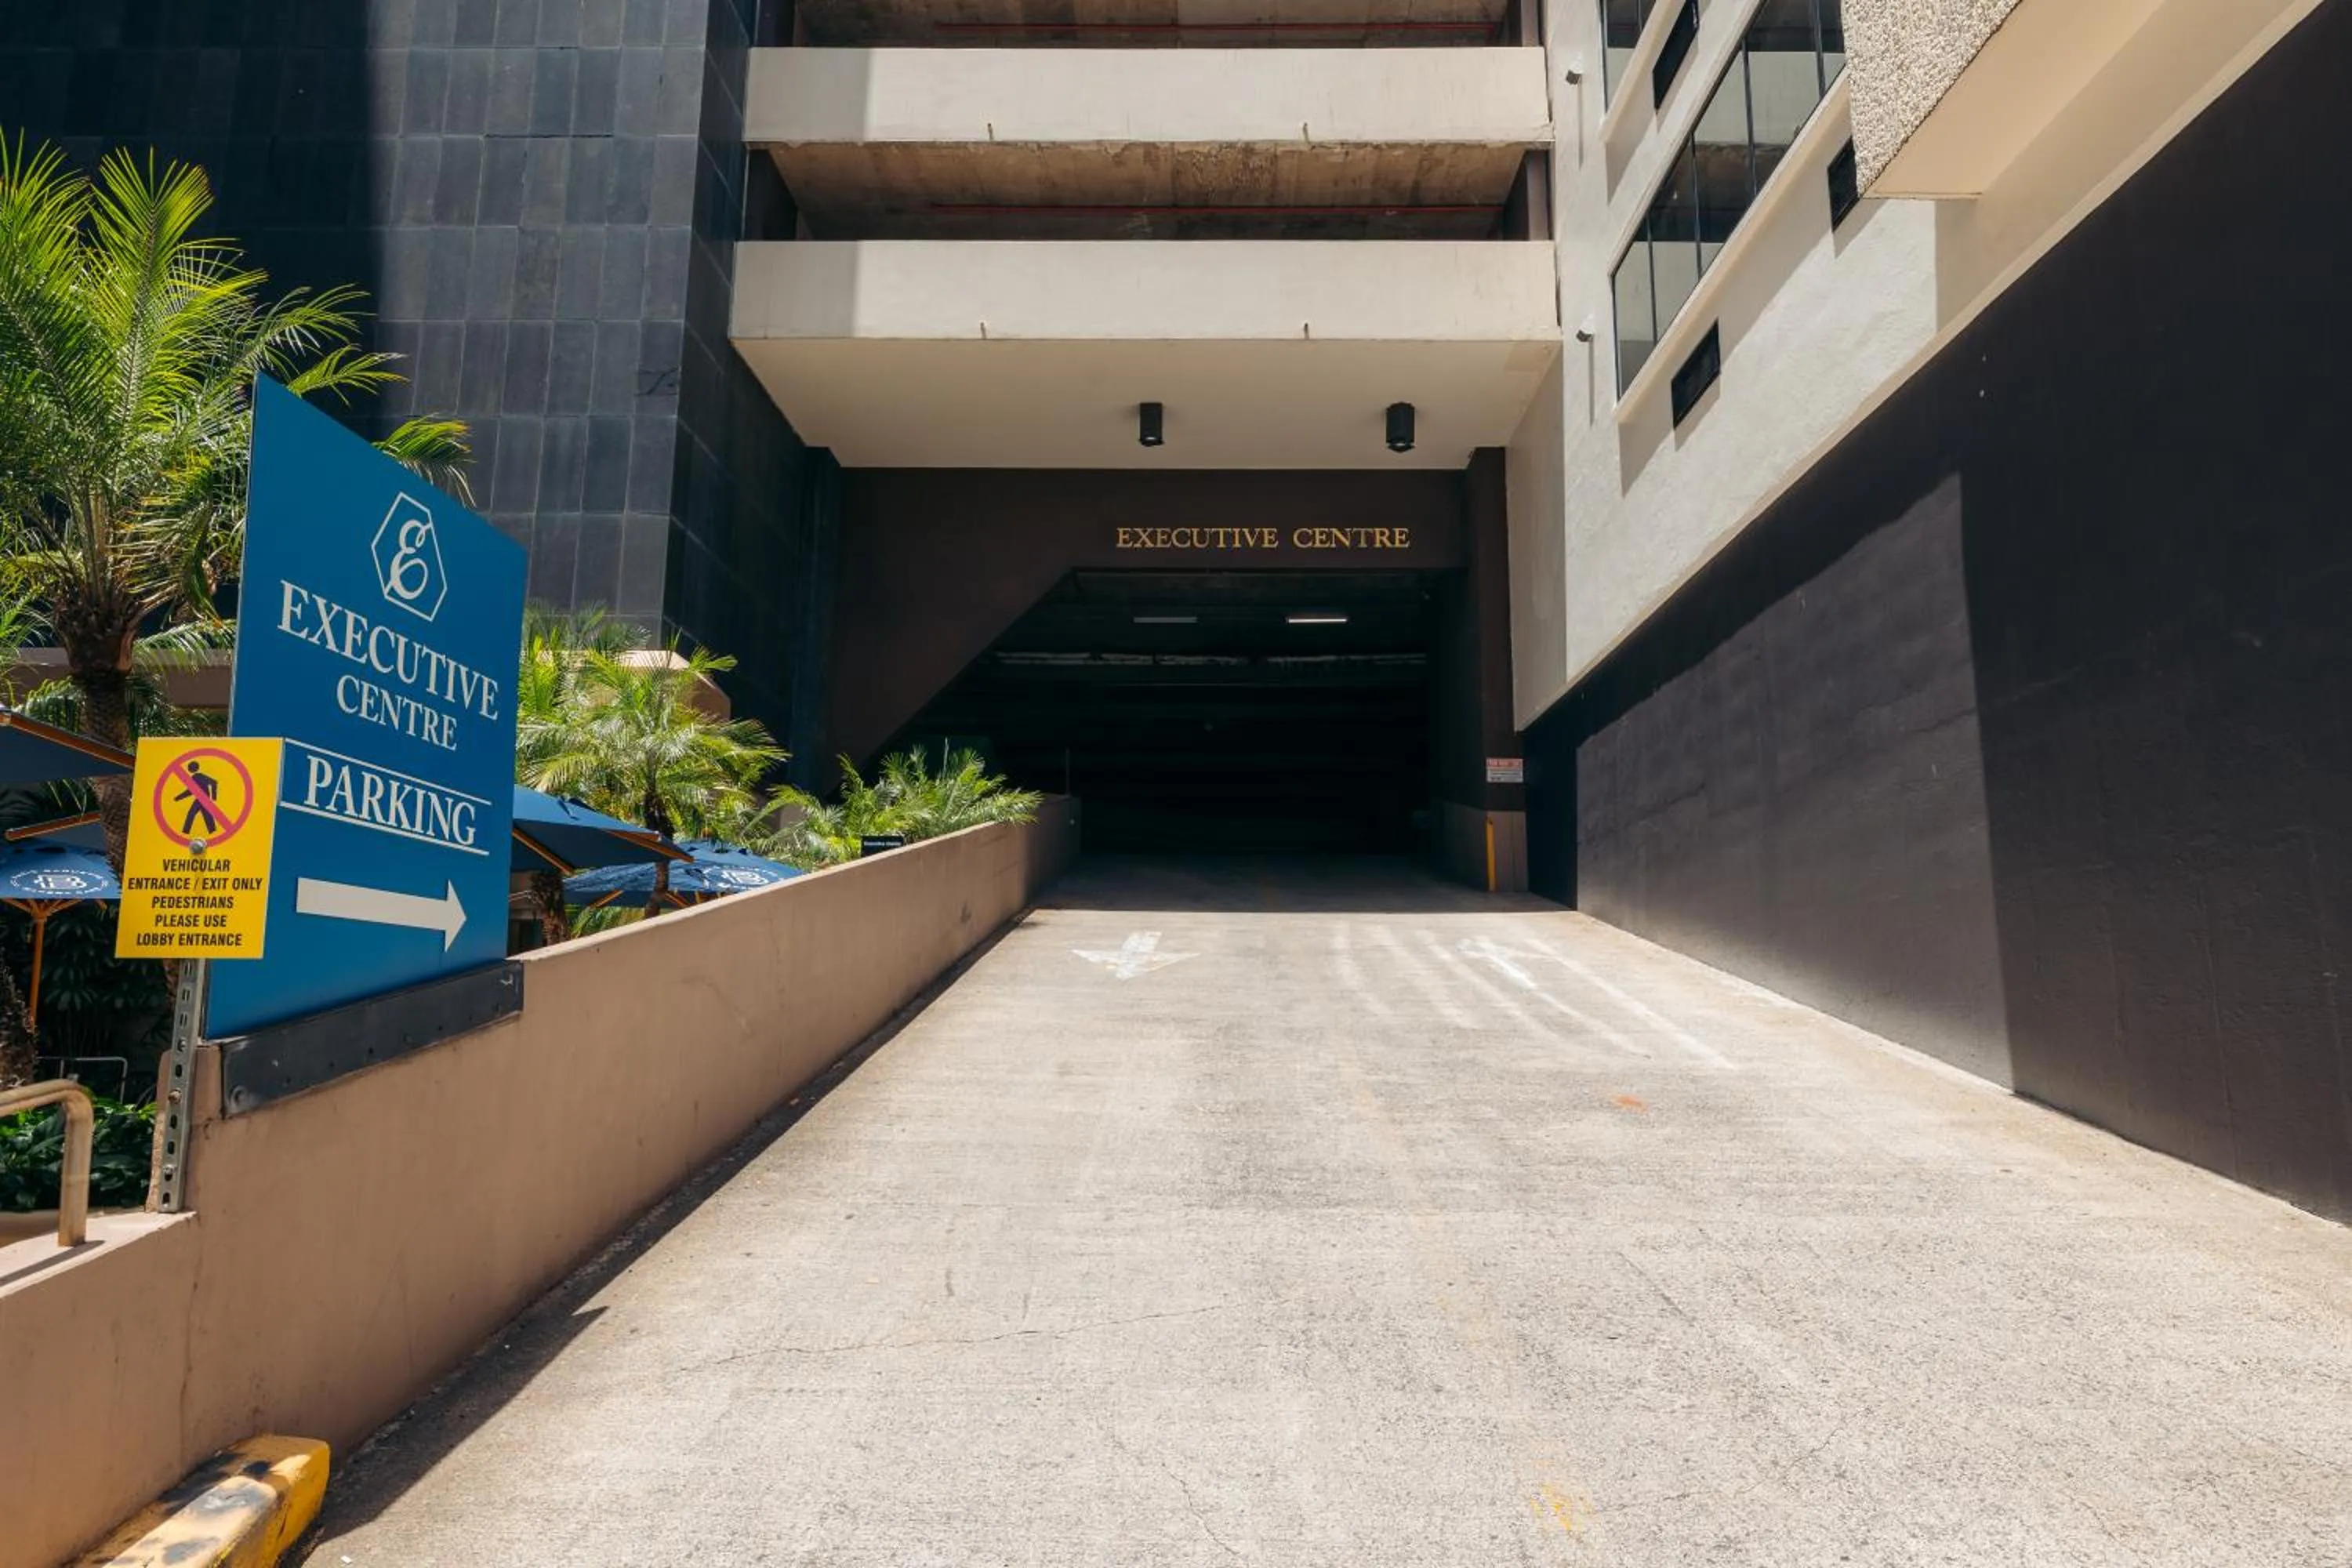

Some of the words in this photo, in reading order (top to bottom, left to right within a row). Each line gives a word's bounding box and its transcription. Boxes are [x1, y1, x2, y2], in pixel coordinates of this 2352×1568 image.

[1116, 528, 1279, 548] EXECUTIVE
[1292, 528, 1410, 548] CENTRE
[277, 579, 499, 720] EXECUTIVE
[336, 674, 457, 750] CENTRE
[303, 755, 476, 845] PARKING
[162, 859, 231, 872] VEHICULAR
[128, 877, 191, 891] ENTRANCE
[201, 877, 229, 890] EXIT
[231, 877, 263, 890] ONLY
[151, 896, 234, 909] PEDESTRIANS
[154, 915, 199, 927] PLEASE
[203, 915, 227, 927] USE
[136, 933, 175, 946] LOBBY
[178, 933, 242, 946] ENTRANCE
